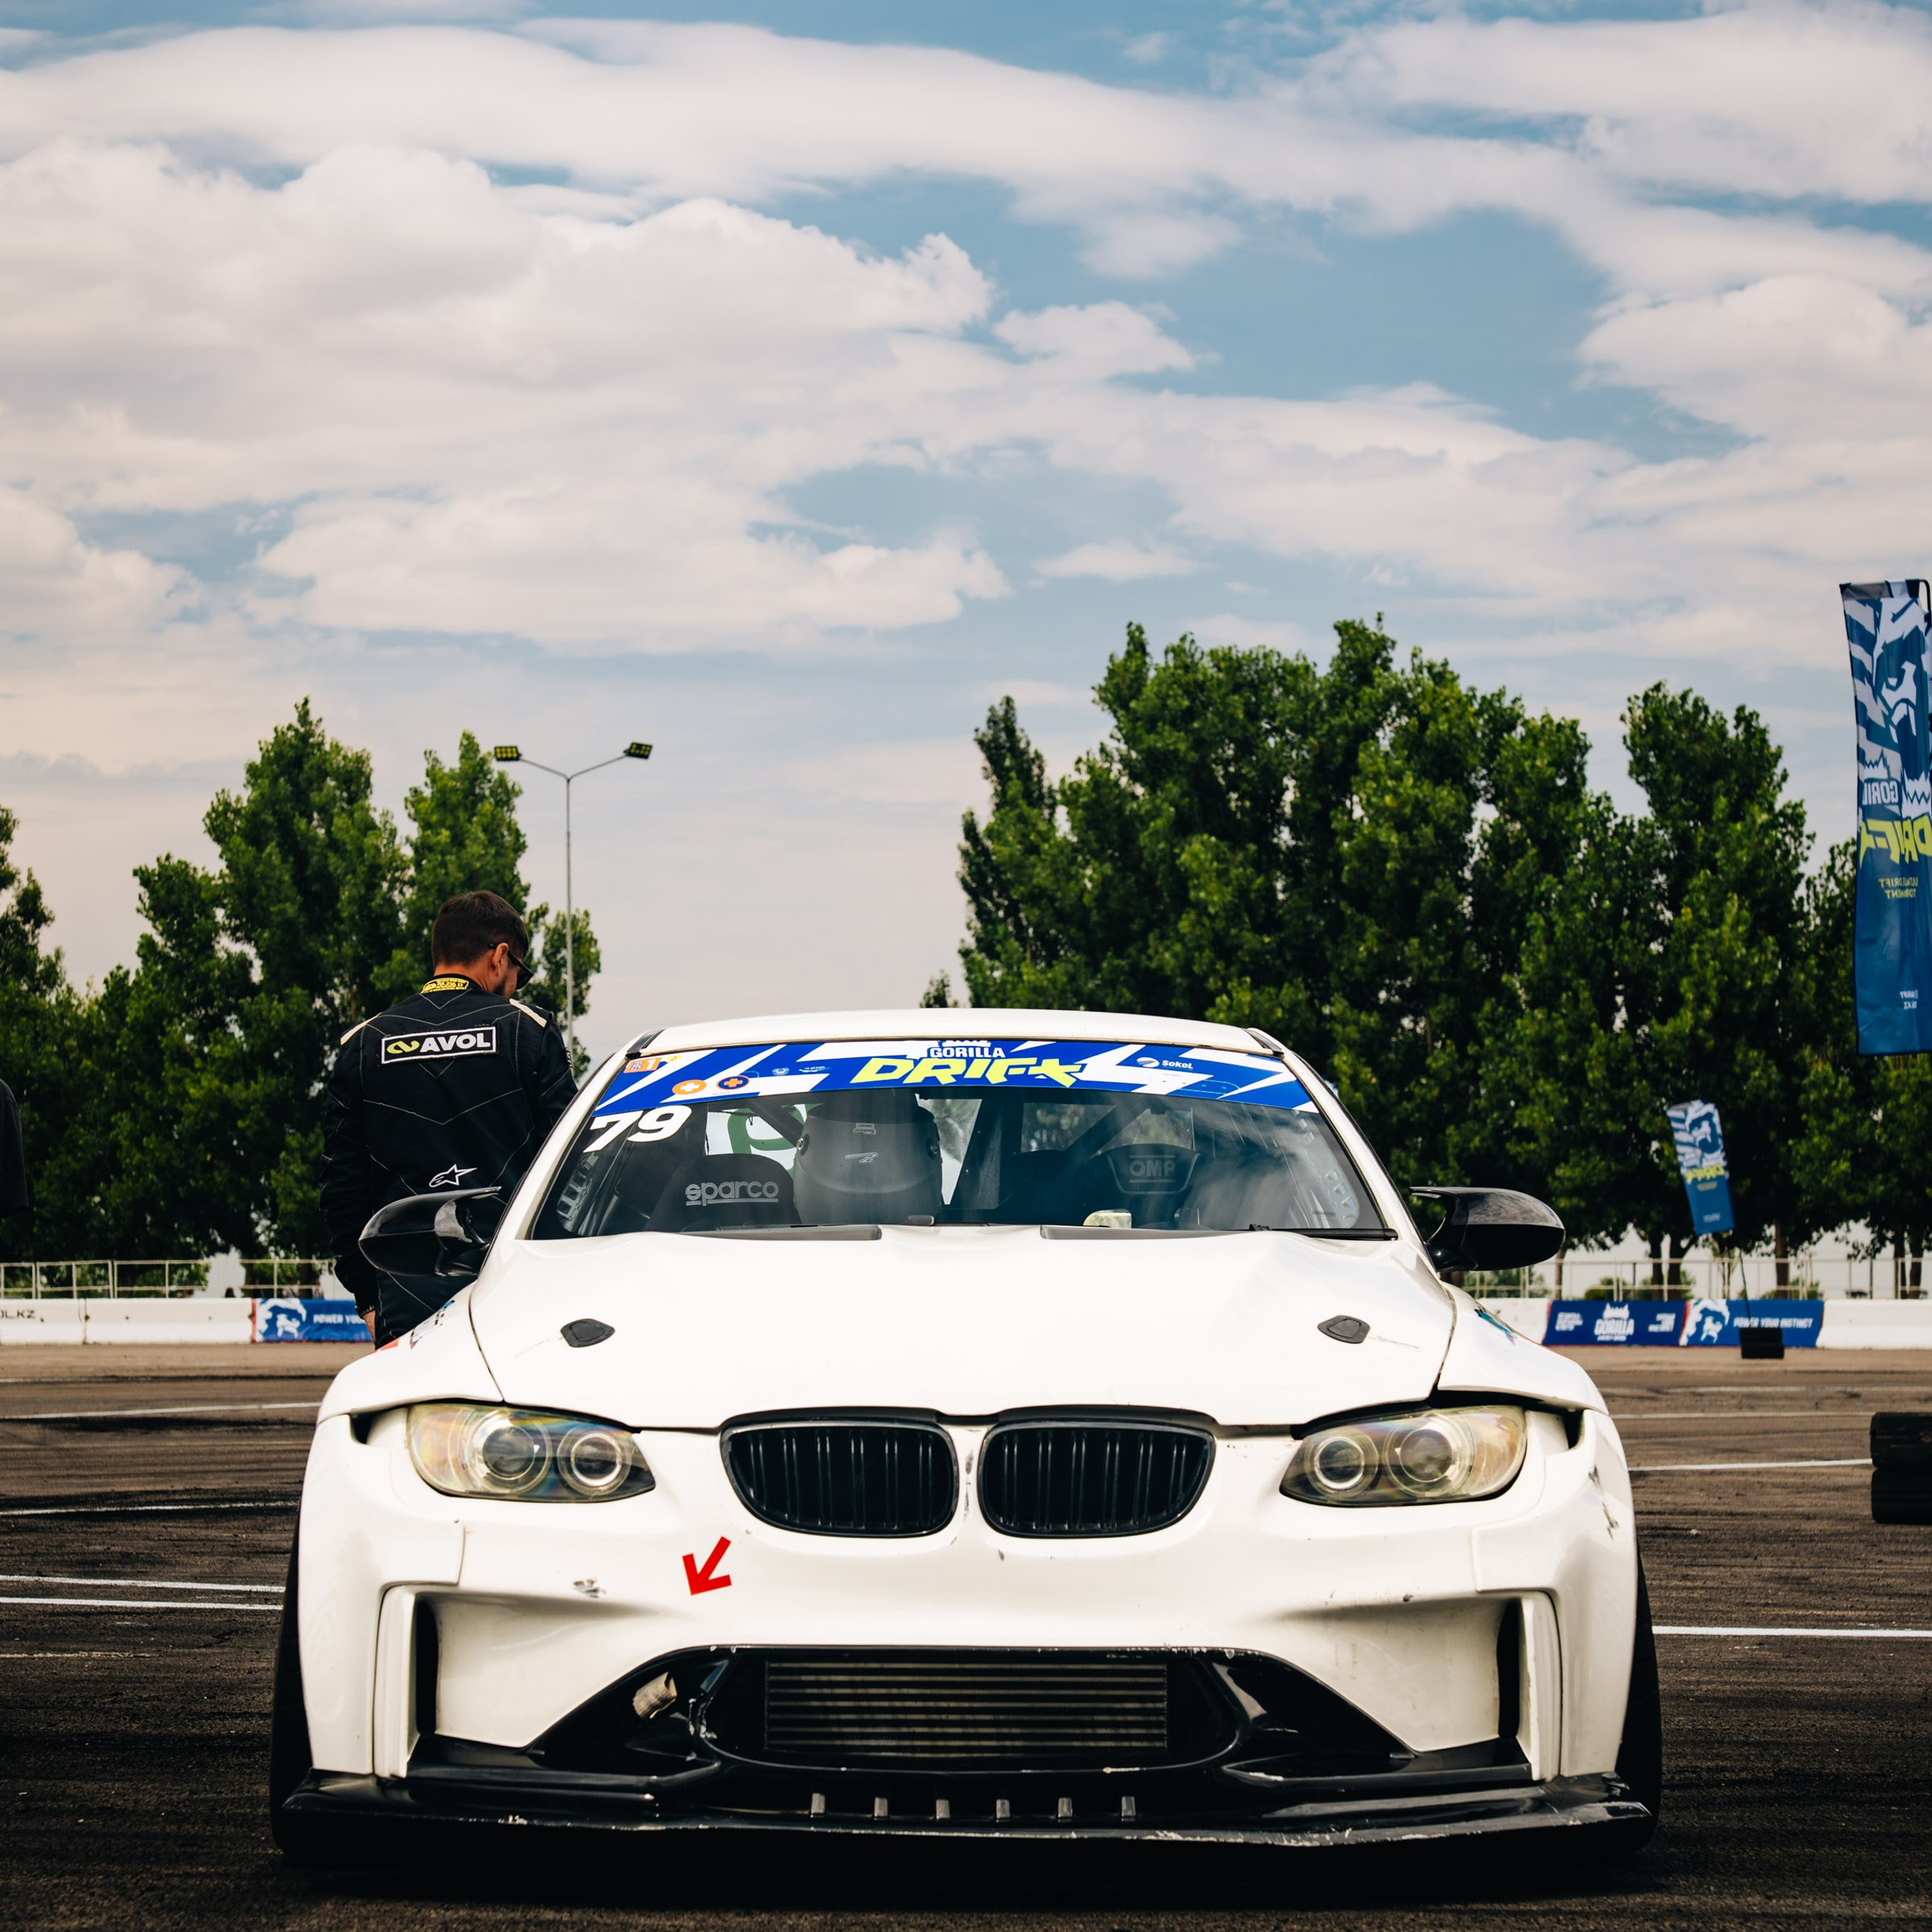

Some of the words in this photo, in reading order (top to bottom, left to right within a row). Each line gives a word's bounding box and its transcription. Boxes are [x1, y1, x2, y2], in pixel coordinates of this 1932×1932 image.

[420, 1032, 491, 1053] AVOL
[929, 1047, 1006, 1058] GORILLA
[850, 1057, 1081, 1088] DRIFT
[583, 1105, 692, 1153] 79
[1129, 1160, 1176, 1177] OMP
[685, 1180, 779, 1207] sparco
[313, 1314, 343, 1324] POWER
[1594, 1318, 1635, 1335] GORILLA
[1734, 1317, 1759, 1328] POWER
